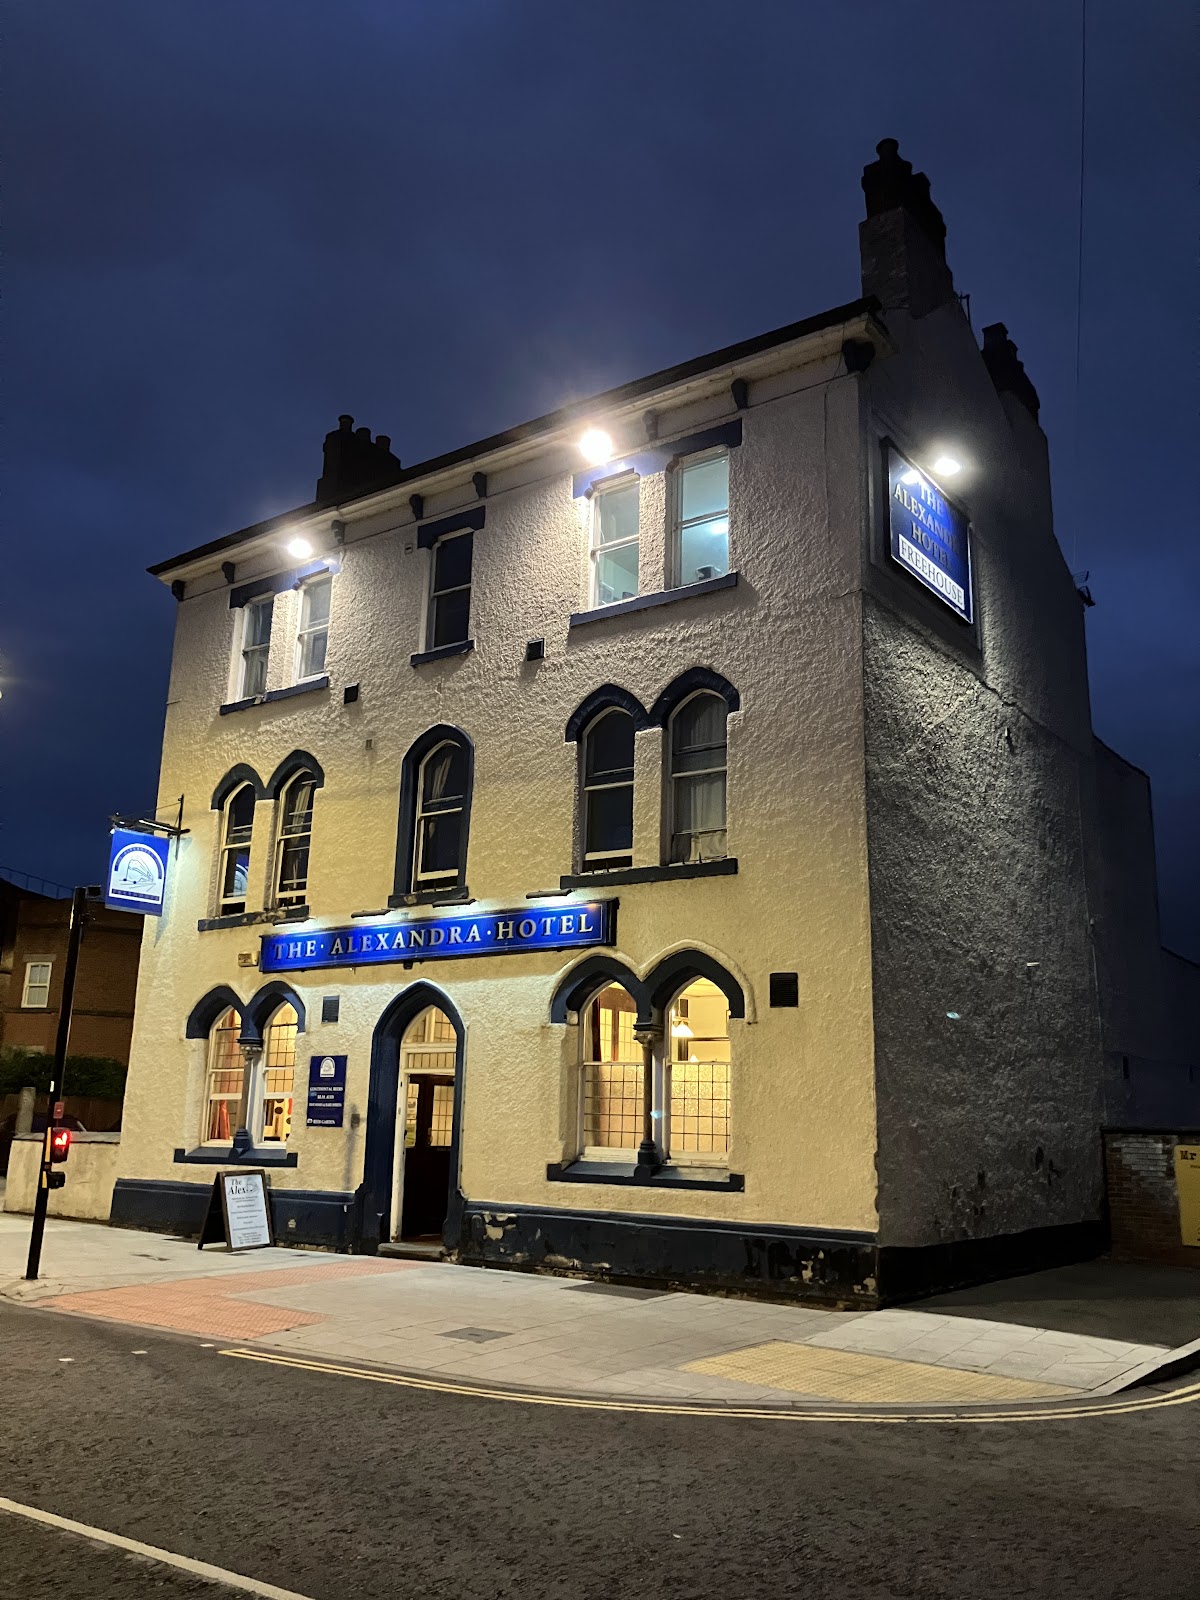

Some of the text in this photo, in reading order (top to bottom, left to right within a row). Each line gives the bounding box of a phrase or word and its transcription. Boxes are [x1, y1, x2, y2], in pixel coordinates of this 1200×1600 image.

[919, 482, 944, 517] THE
[901, 539, 964, 605] FREEHOUSE
[274, 913, 594, 960] THE ALEXANDRA HOTEL
[231, 1178, 242, 1186] The
